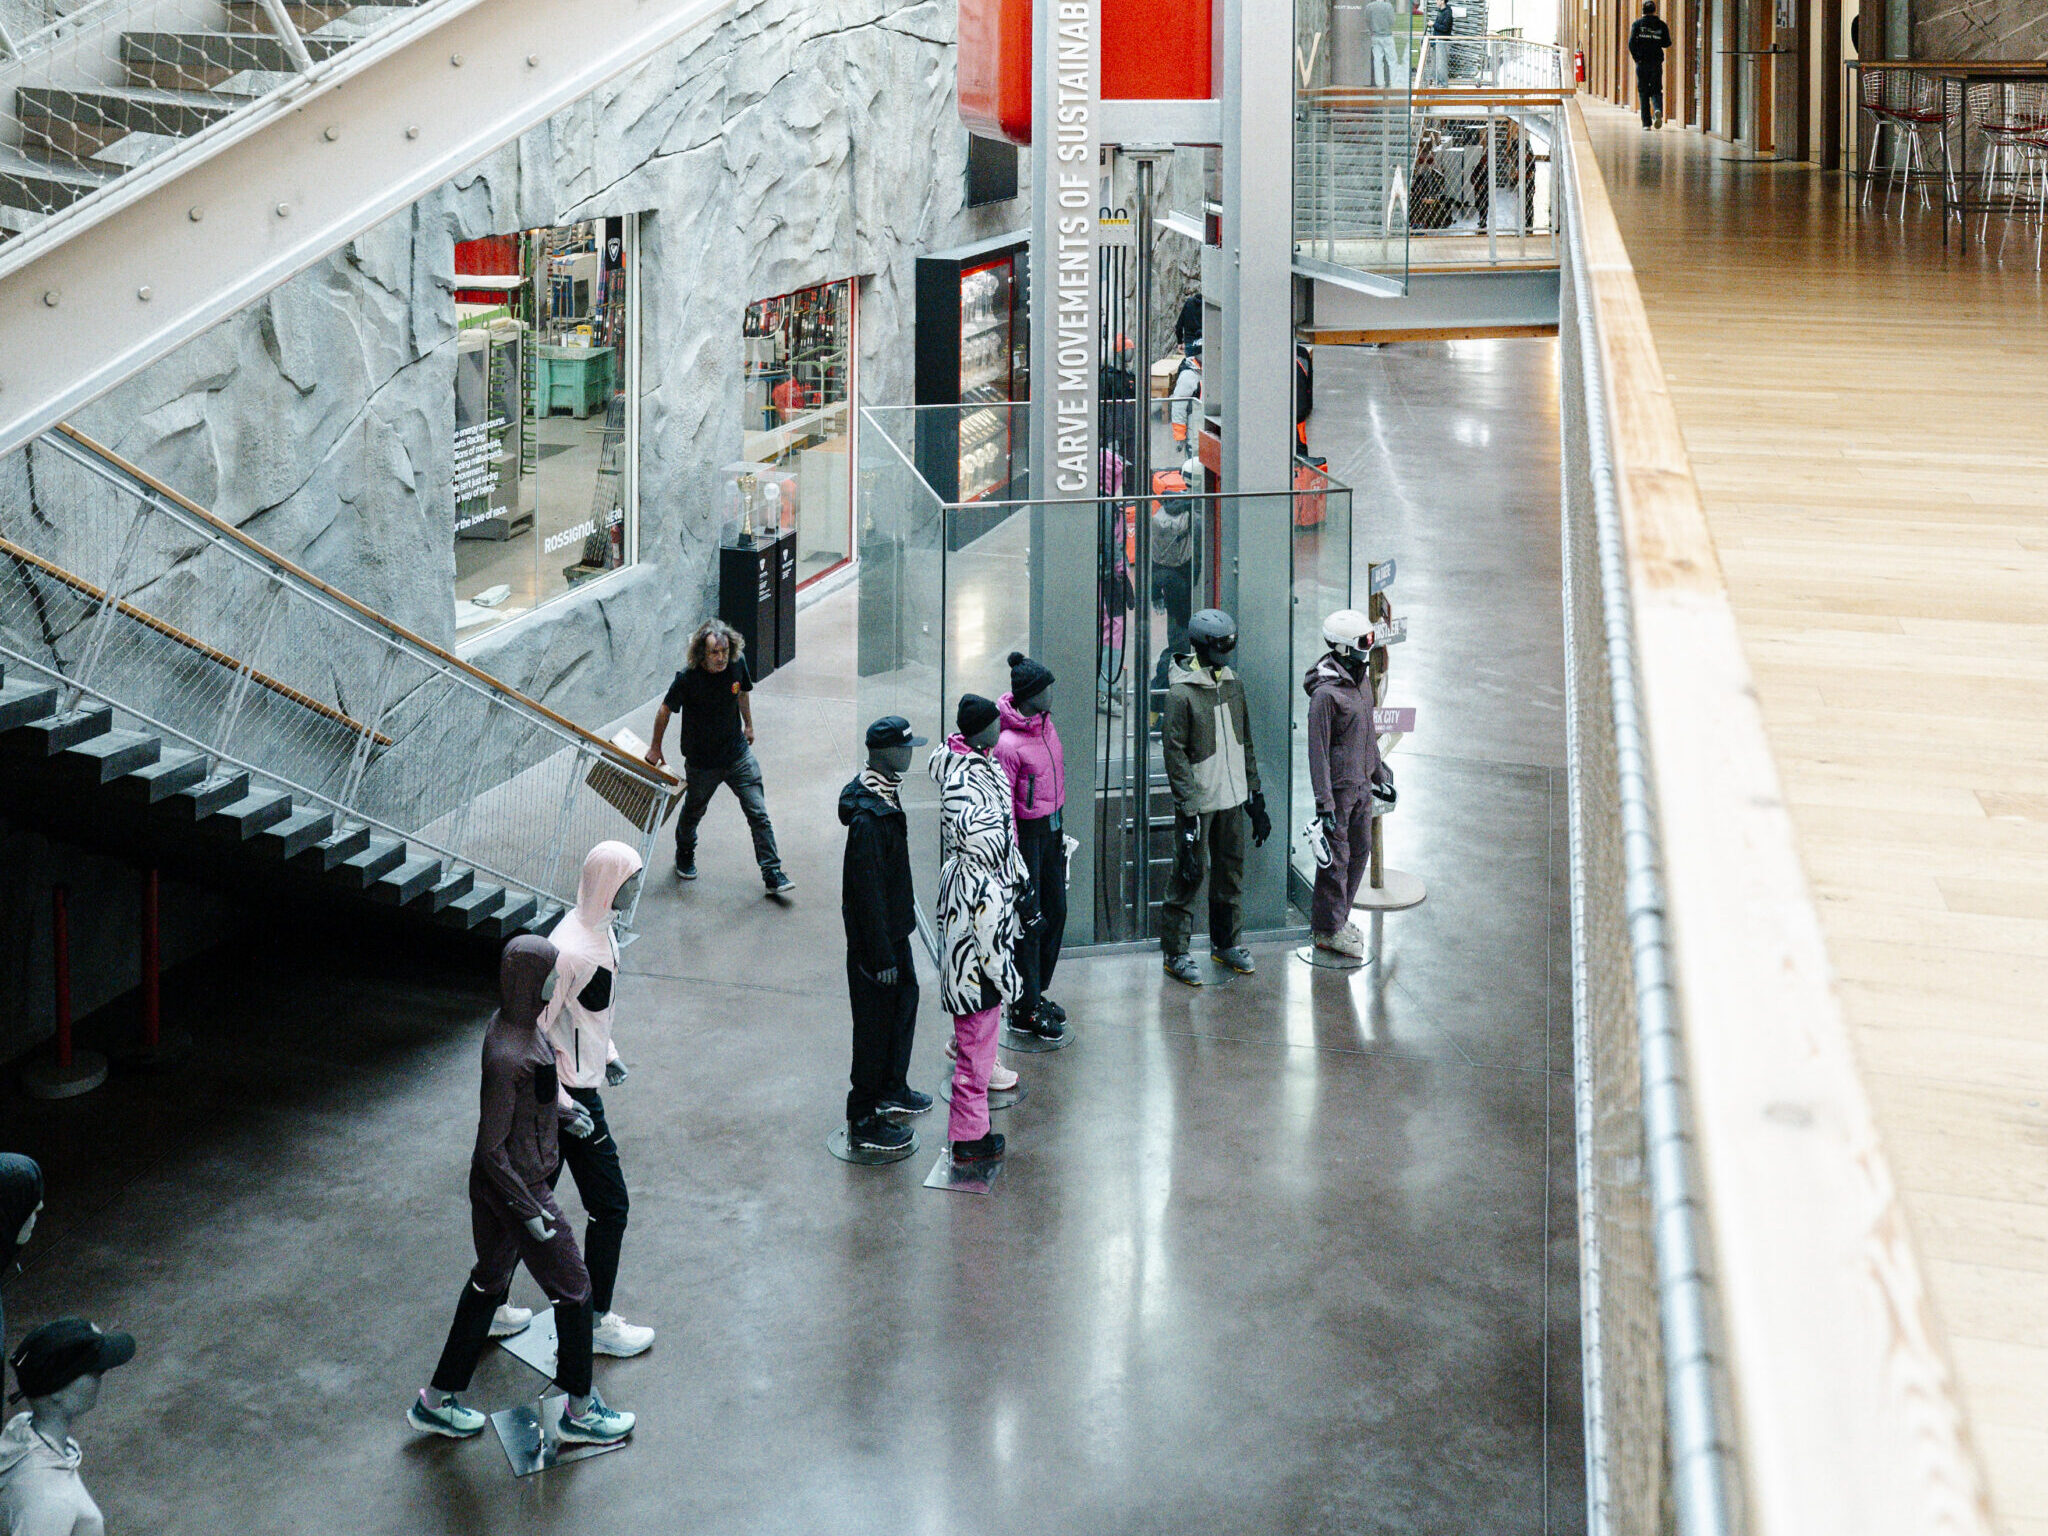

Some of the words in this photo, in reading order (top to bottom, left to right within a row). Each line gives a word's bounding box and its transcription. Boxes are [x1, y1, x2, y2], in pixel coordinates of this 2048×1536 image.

[1057, 2, 1089, 162] SUSTAINAB
[1059, 173, 1090, 208] OF
[1057, 215, 1089, 391] MOVEMENTS
[469, 445, 475, 455] of
[1056, 399, 1088, 492] CARVE
[473, 486, 480, 497] of
[460, 518, 471, 530] the
[471, 514, 485, 526] love
[485, 508, 493, 520] of
[544, 519, 597, 554] ROSSIGNOL
[1383, 709, 1400, 724] CITY
